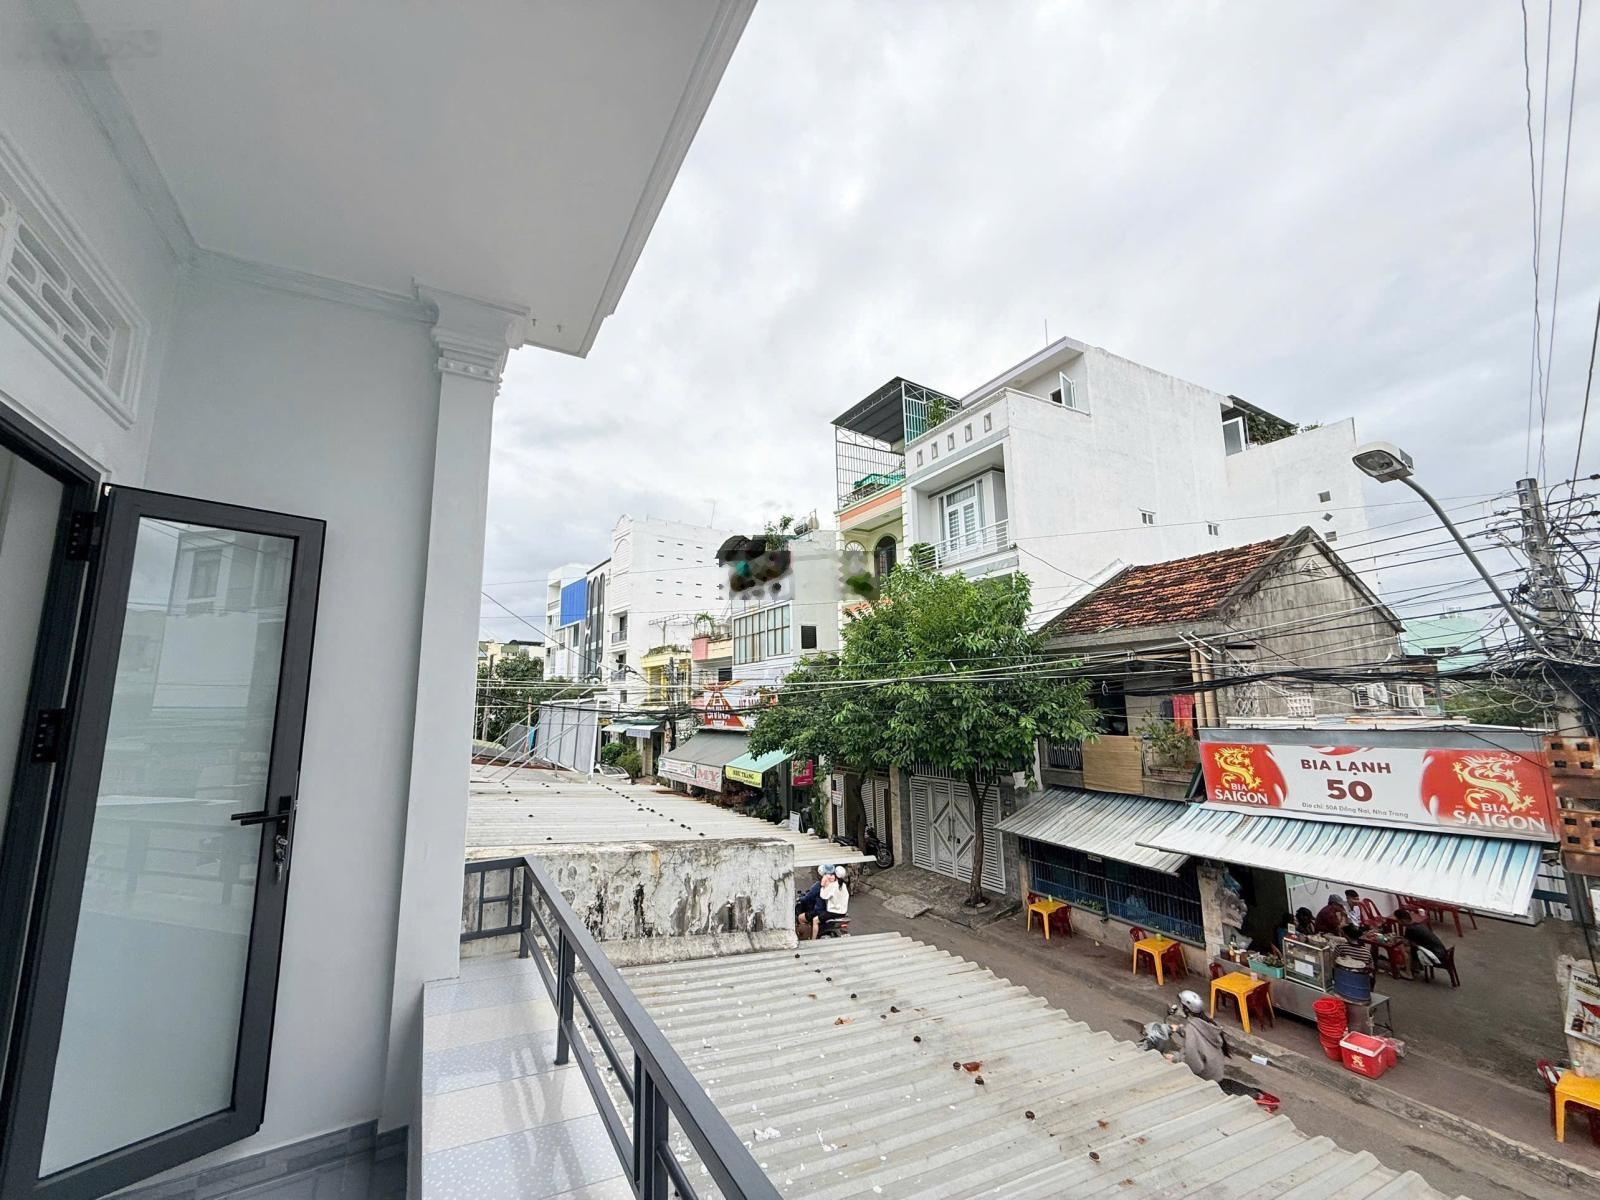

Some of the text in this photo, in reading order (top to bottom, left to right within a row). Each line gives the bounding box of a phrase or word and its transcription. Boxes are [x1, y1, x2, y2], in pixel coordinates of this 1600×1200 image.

[1300, 759, 1392, 776] BIA LẠNH
[1231, 783, 1249, 791] BIA
[1326, 779, 1373, 802] 50
[1214, 788, 1269, 805] SAIGON
[1388, 810, 1409, 819] Trang
[1481, 802, 1511, 814] BIA
[1452, 809, 1548, 833] SAIGON
